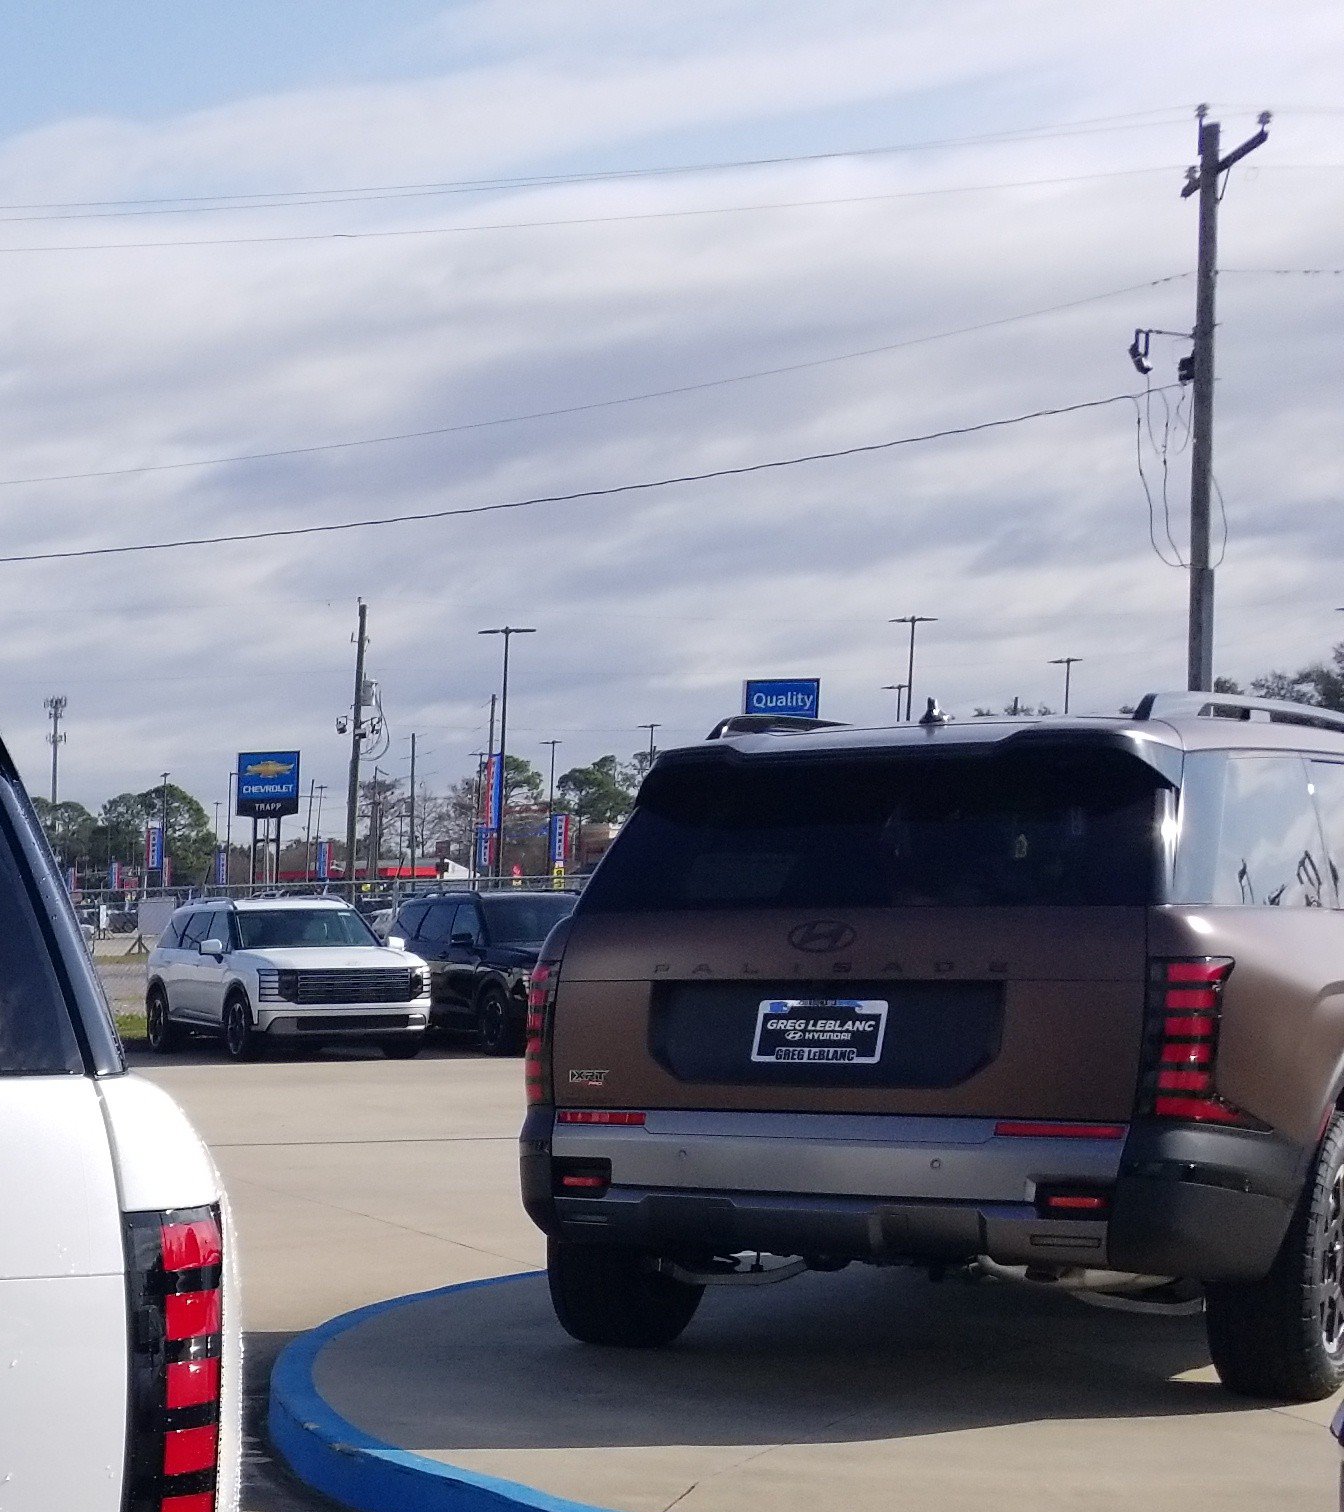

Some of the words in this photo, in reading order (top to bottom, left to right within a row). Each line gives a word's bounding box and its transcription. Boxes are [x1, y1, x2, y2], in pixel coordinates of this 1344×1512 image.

[753, 692, 814, 709] Quality
[242, 784, 293, 793] CHEVROLET
[767, 1020, 805, 1030] GREG
[807, 1020, 875, 1031] LEBLANC
[805, 1032, 852, 1040] HYUNDAI
[775, 1049, 804, 1060] GREG
[570, 1070, 609, 1082] XRT
